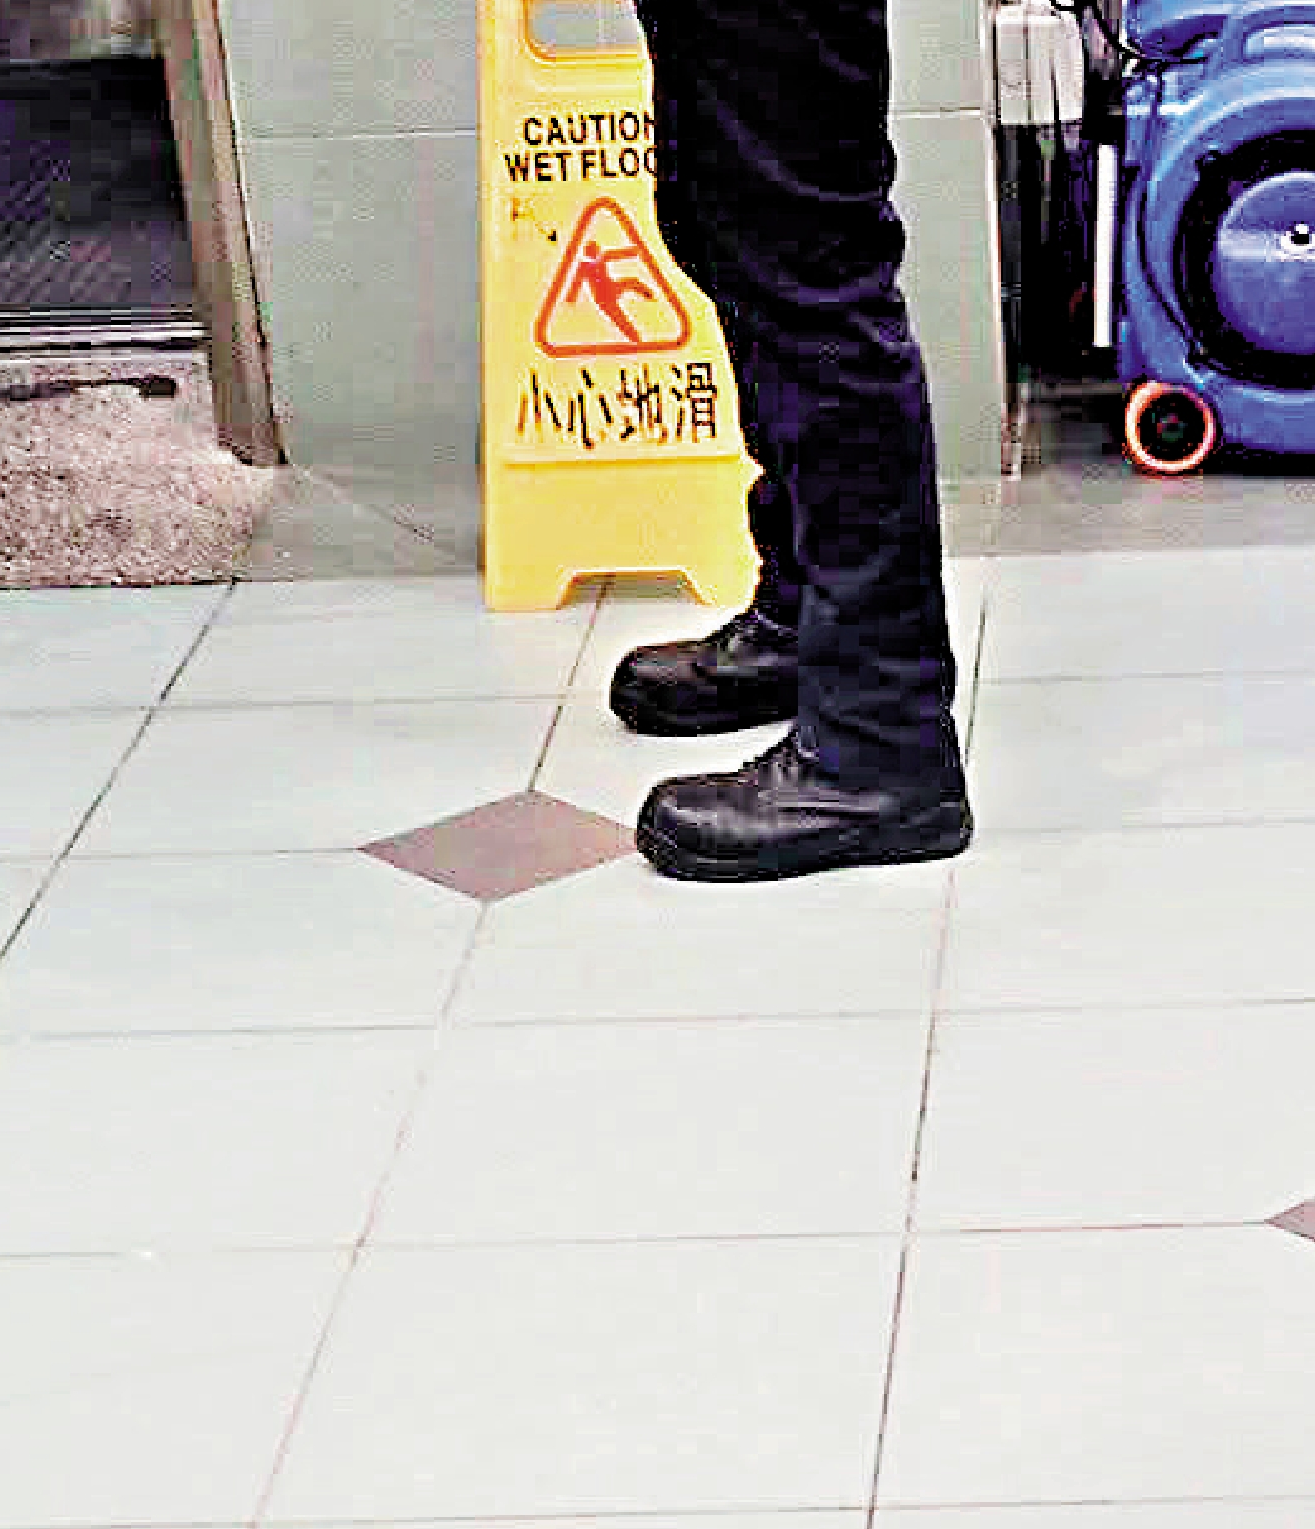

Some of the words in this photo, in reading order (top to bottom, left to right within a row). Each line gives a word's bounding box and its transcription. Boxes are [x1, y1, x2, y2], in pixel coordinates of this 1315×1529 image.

[503, 150, 572, 181] WET
[581, 146, 657, 181] FLOO
[516, 362, 718, 451] 小心地滑
